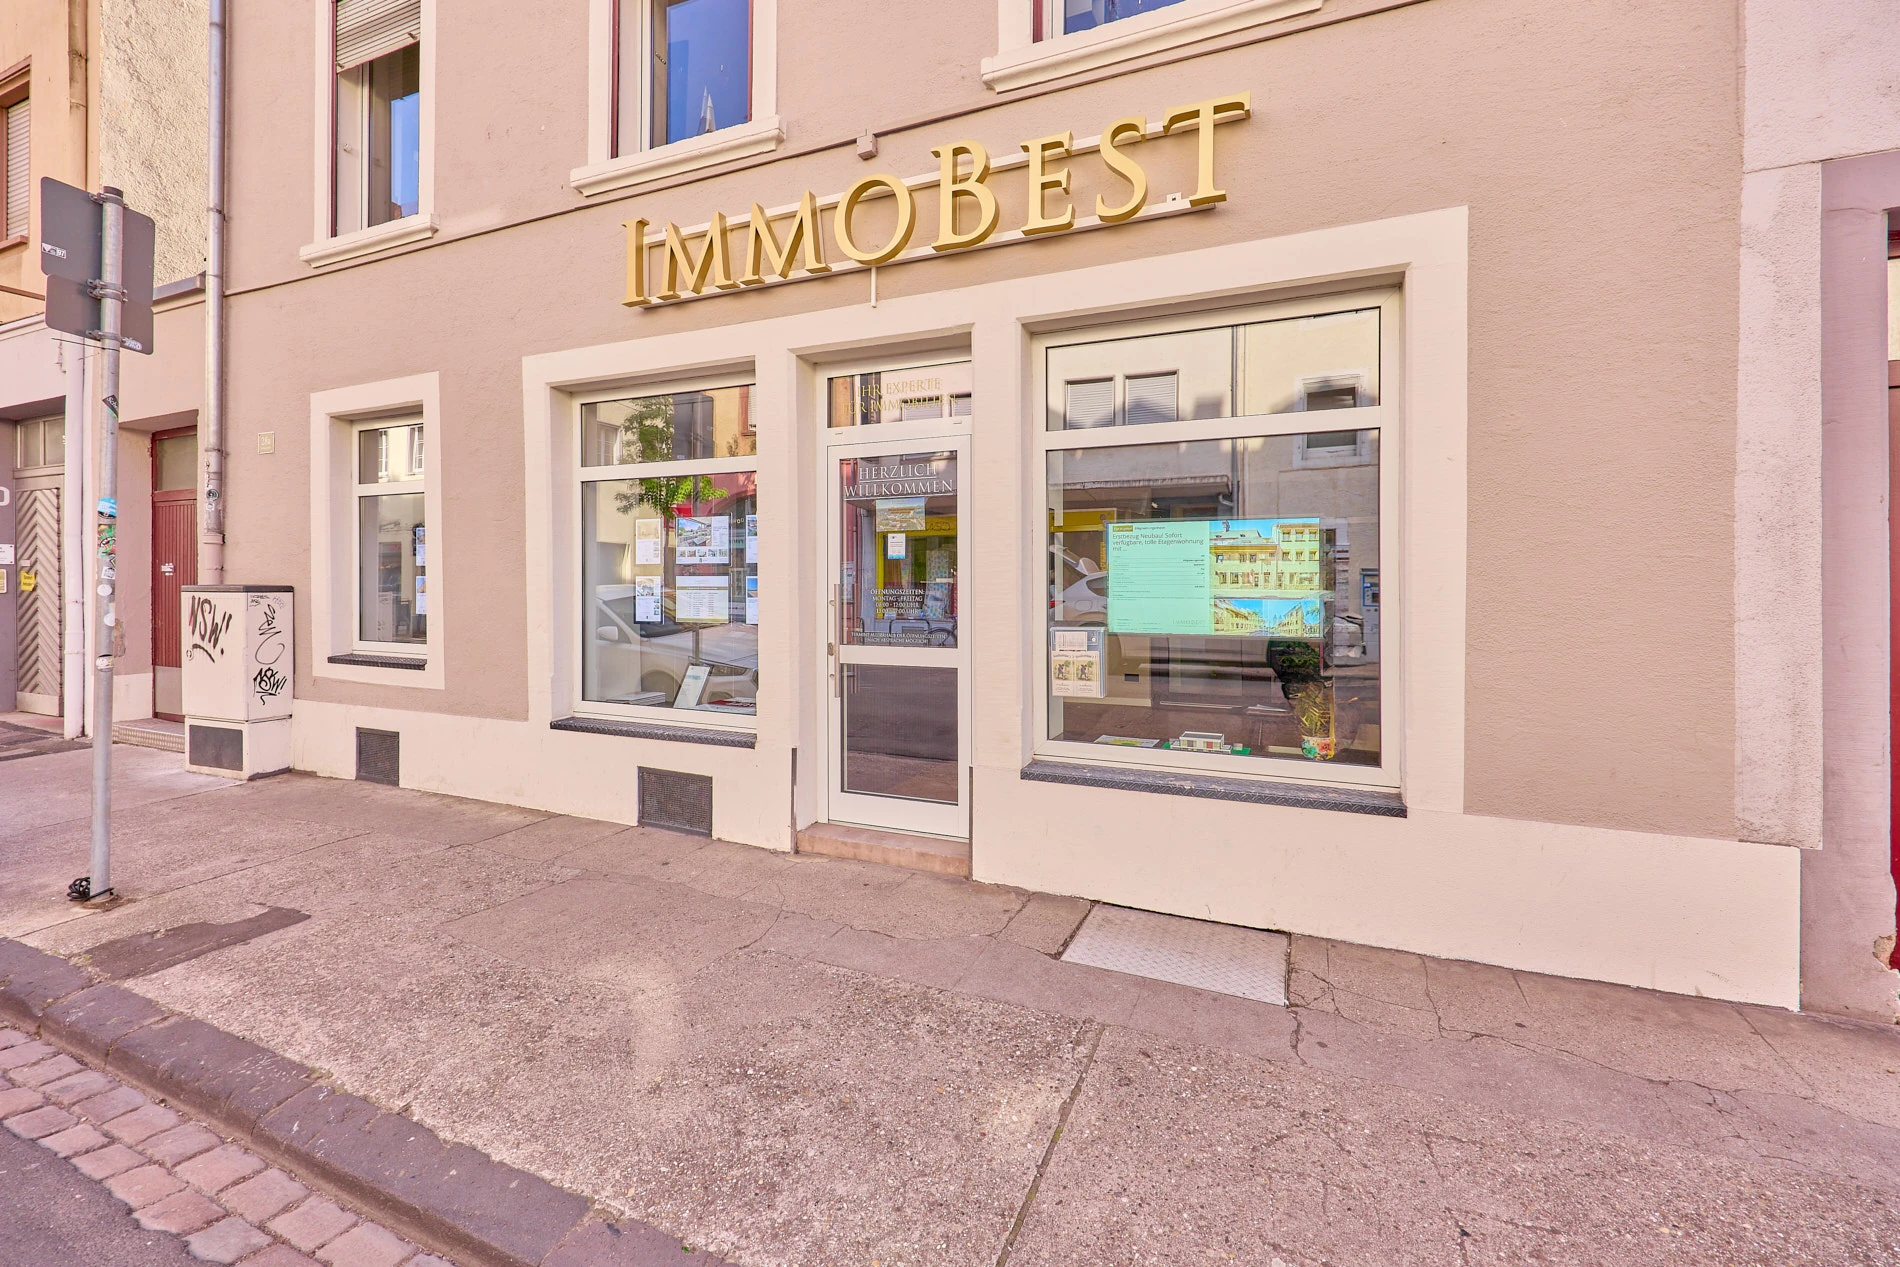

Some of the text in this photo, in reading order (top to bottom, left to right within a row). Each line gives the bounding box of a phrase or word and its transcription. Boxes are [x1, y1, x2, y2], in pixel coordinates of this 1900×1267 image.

[620, 89, 1252, 308] IMMOBEST
[857, 378, 941, 397] IHR EXPERTE
[871, 393, 957, 412] IMMOBILIEN
[859, 463, 936, 480] HERZLICH
[843, 479, 954, 497] WILLKOMMEN
